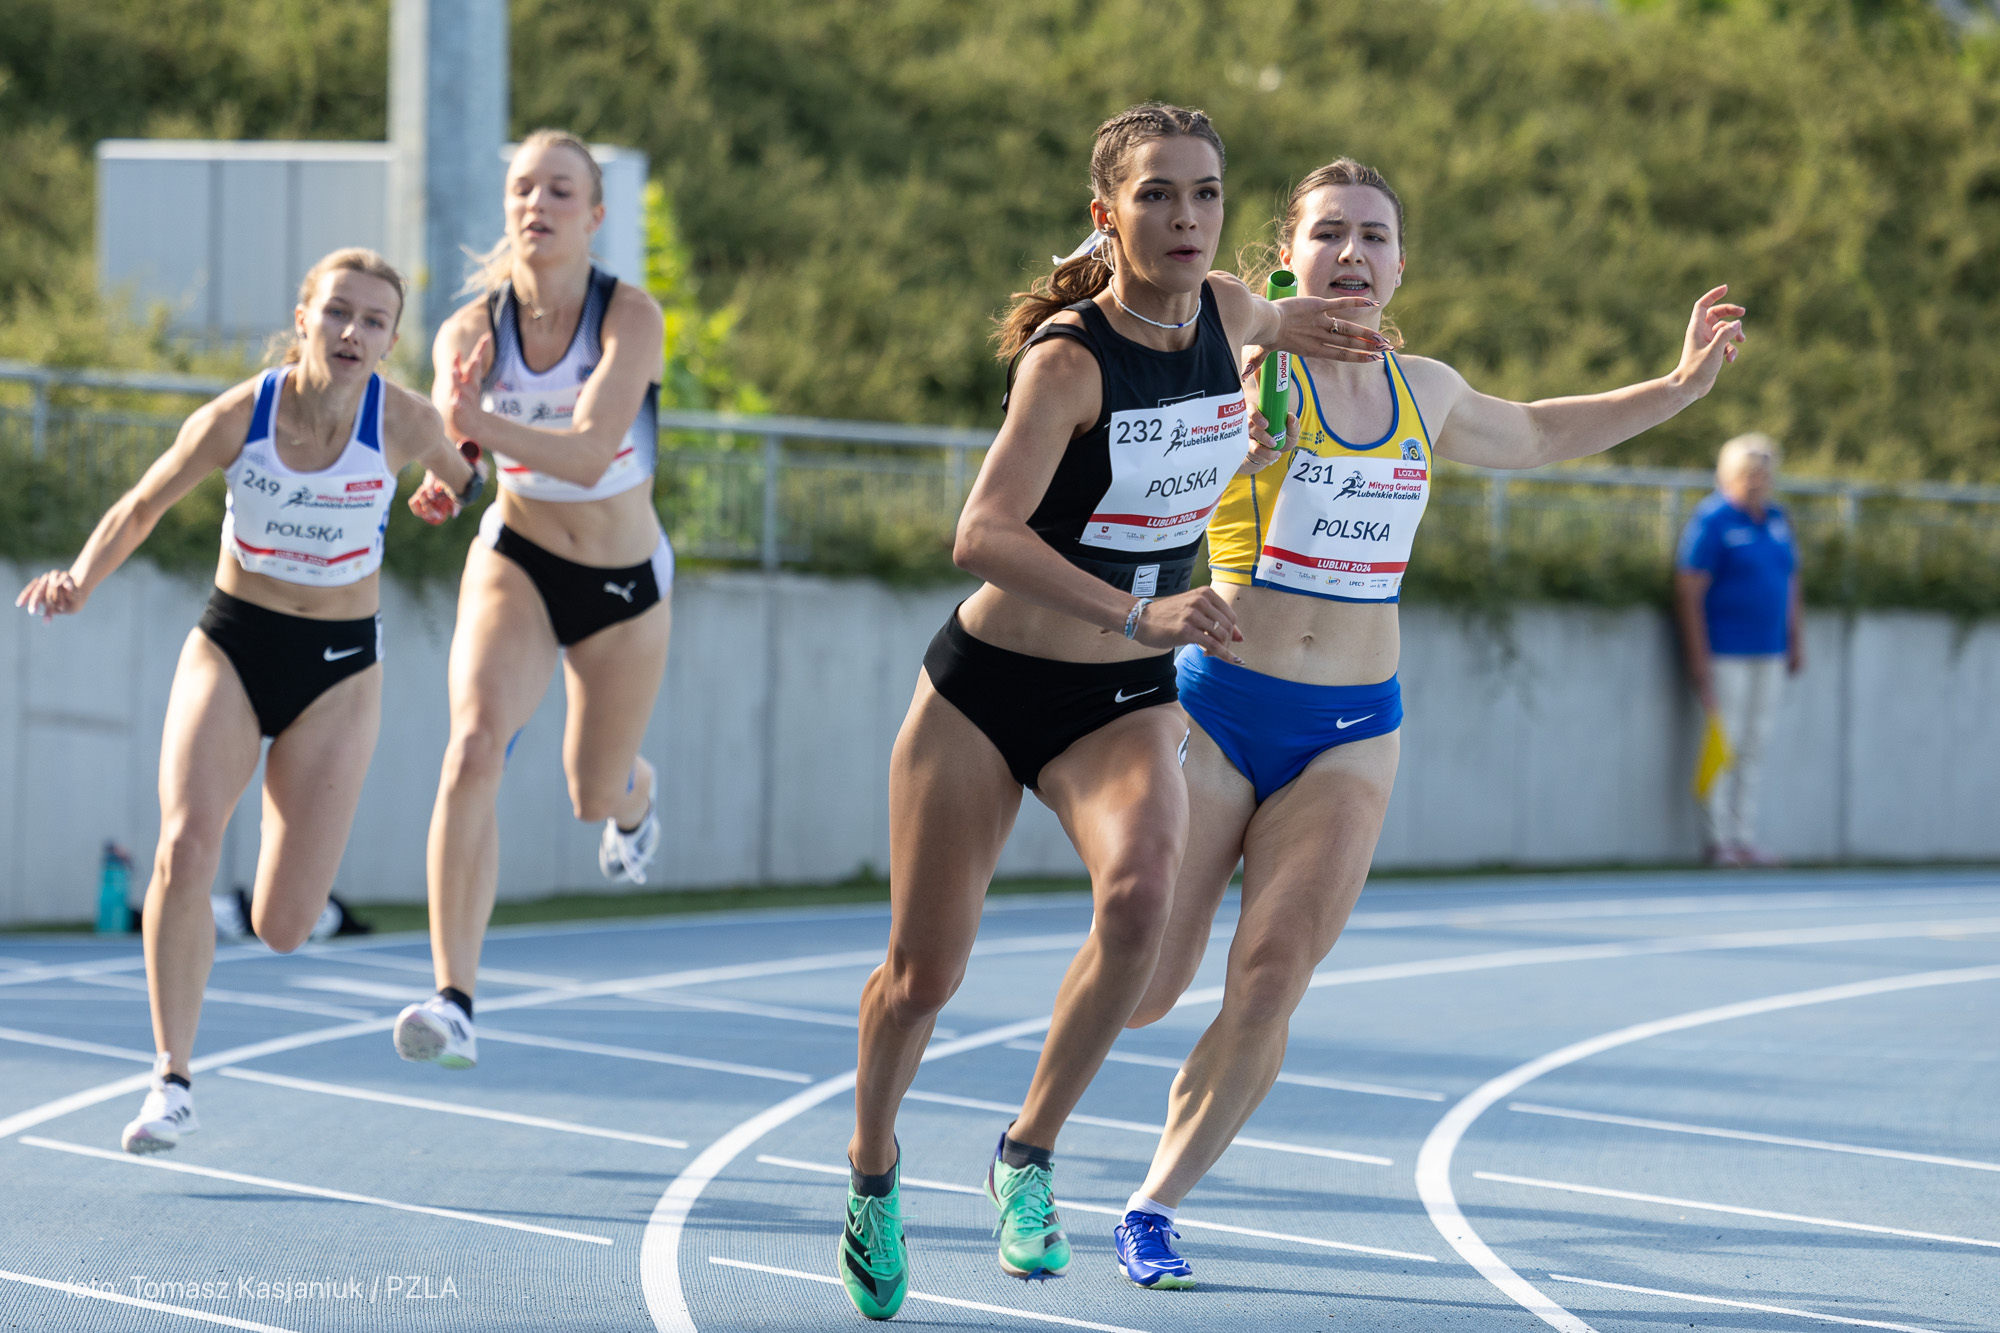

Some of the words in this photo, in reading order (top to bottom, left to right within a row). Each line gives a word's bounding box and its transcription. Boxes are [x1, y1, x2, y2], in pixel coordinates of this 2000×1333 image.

[1223, 402, 1245, 414] LOZLA
[1116, 418, 1163, 444] 232
[1191, 424, 1219, 436] Mityng
[1220, 416, 1244, 430] Gwiazd
[1183, 434, 1219, 448] Lubelskie
[1219, 426, 1243, 441] Koziołki
[242, 469, 281, 497] 249
[1145, 467, 1218, 498] POLSKA
[1292, 462, 1334, 485] 231
[1397, 469, 1422, 478] LOZLA
[1357, 490, 1392, 500] Lubelskie
[1392, 491, 1421, 501] Koziołki
[1368, 481, 1395, 492] Mityng
[1395, 482, 1422, 492] Gwiazd
[1146, 516, 1179, 528] LUBLIN
[1178, 511, 1198, 524] 2024
[1311, 518, 1391, 542] POLSKA
[265, 520, 344, 543] POLSKA
[1317, 560, 1350, 571] LUBLIN
[1350, 562, 1372, 573] 2024
